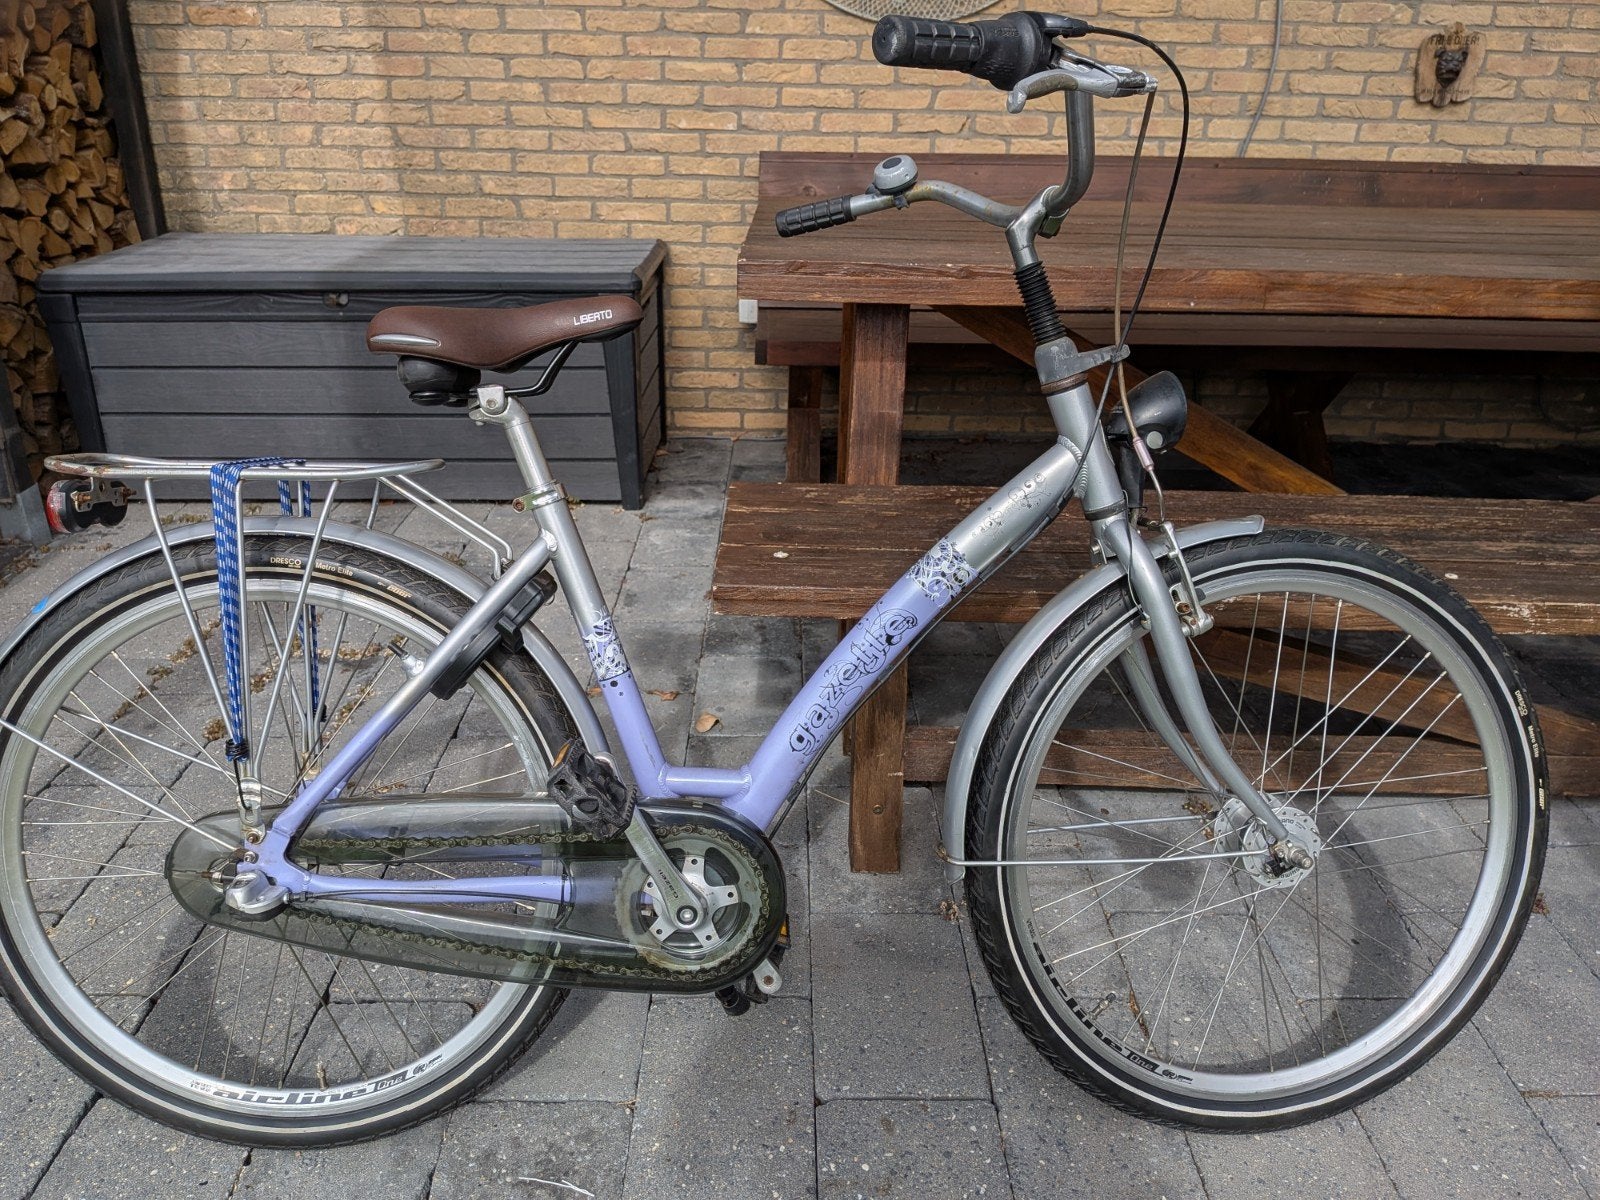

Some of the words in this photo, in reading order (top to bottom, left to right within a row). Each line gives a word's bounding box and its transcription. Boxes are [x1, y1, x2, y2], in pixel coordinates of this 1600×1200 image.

[573, 309, 613, 326] LIBERTO
[270, 556, 302, 567] DRESCO
[315, 561, 336, 573] Metro
[337, 565, 354, 577] Elite
[1033, 942, 1123, 1053] airline
[213, 1087, 367, 1105] airline
